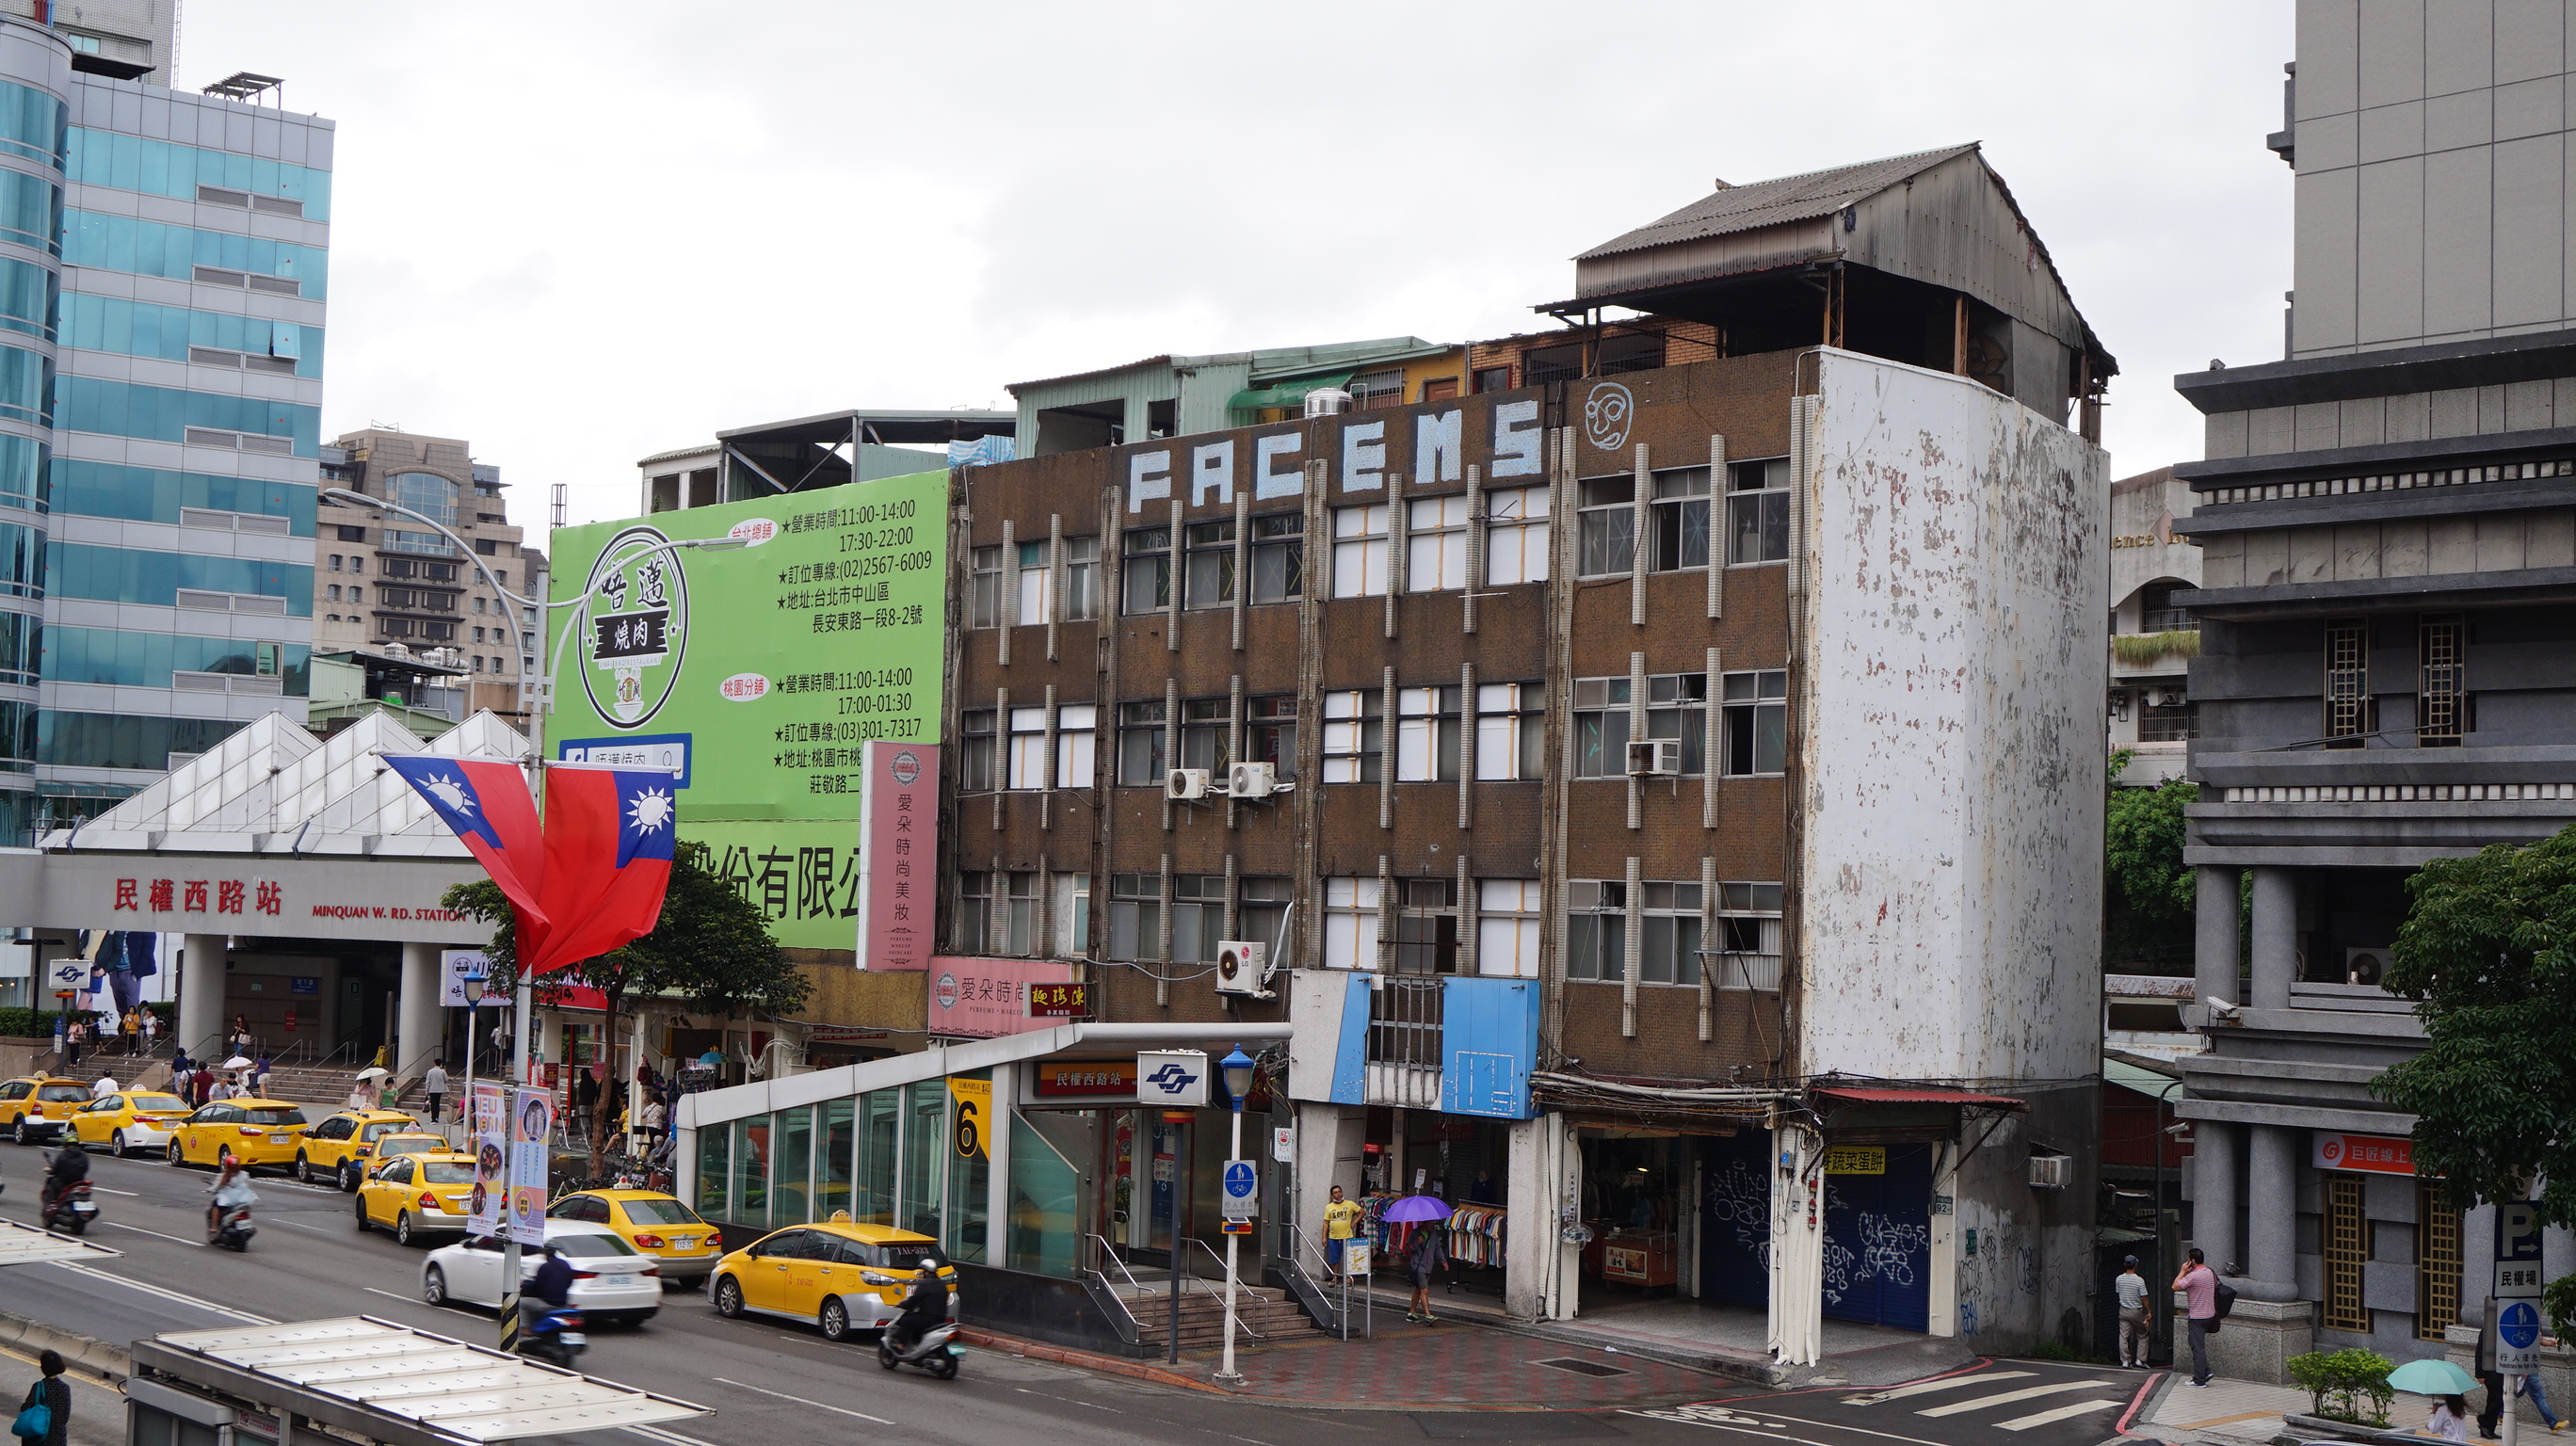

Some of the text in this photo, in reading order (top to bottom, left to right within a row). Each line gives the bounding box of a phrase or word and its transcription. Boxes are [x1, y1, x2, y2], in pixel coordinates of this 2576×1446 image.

[840, 526, 913, 553] 17:30-22:00
[813, 604, 923, 634] 長安東路一段8-2號
[838, 693, 911, 715] 17:00-01:30
[894, 794, 912, 921] 愛朵時尚美妝
[114, 878, 282, 915] 民權西路站
[313, 906, 466, 922] MINQUAN W. RD. STATION
[1241, 959, 1249, 968] LG
[1056, 1072, 1121, 1086] 民權西路站
[955, 1101, 978, 1157] 6
[2502, 1204, 2537, 1258] P
[2501, 1270, 2536, 1287] 民權場
[2500, 1353, 2538, 1362] 行人優先
